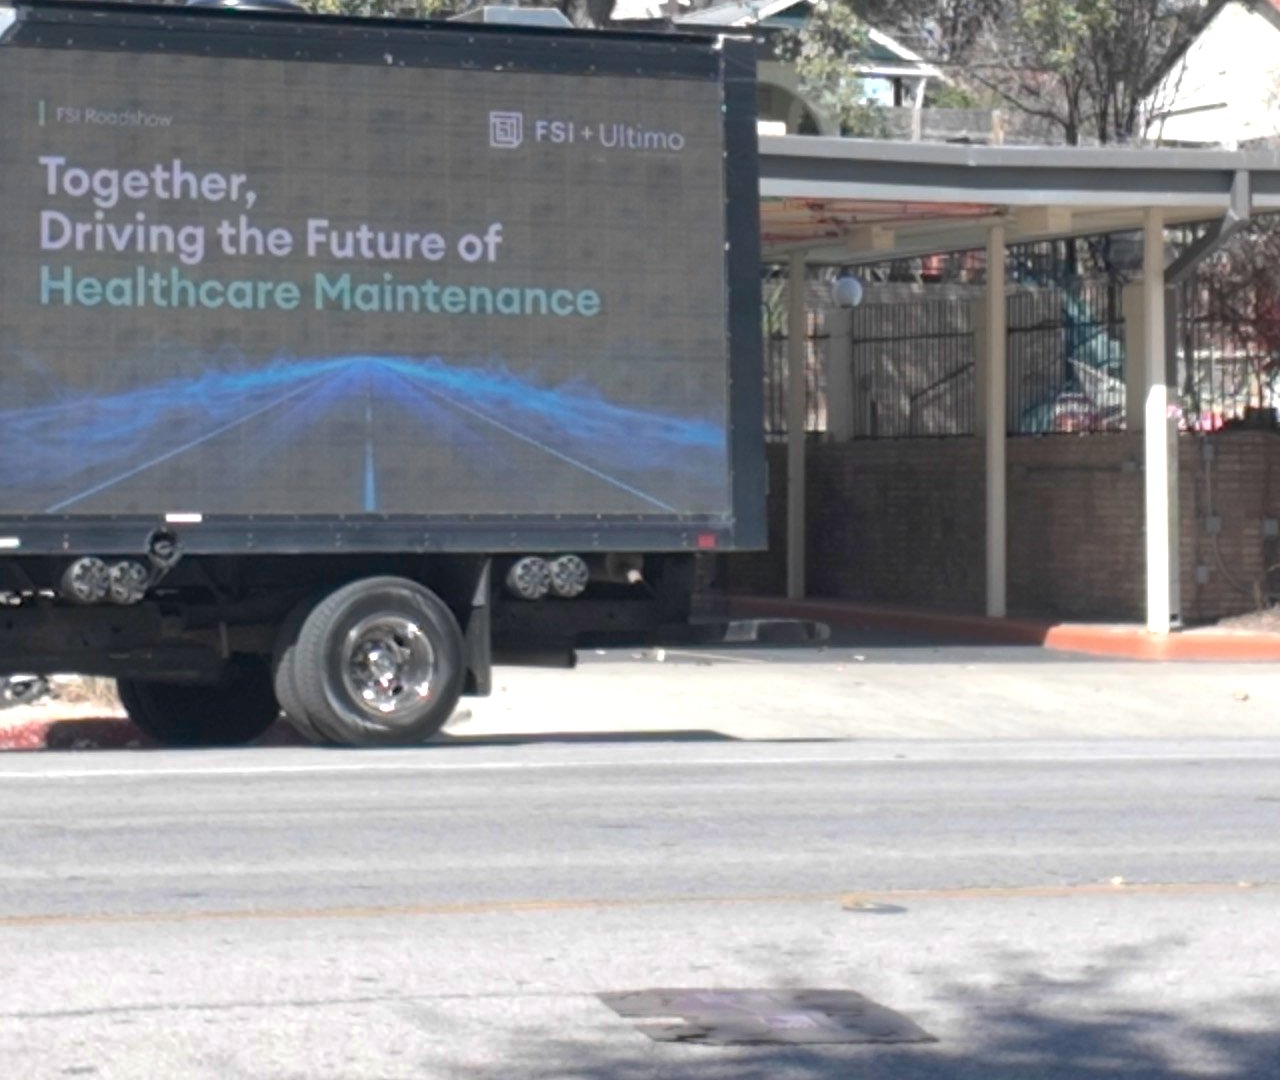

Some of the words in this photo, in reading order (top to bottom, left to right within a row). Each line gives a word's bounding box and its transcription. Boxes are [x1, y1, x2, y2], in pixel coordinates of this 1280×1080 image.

[56, 107, 81, 123] FSI
[85, 108, 173, 127] Roadshow
[535, 120, 574, 143] FSI
[599, 123, 685, 151] Ultimo
[39, 156, 257, 209] Together,
[39, 210, 206, 267] Driving
[217, 217, 293, 257] the
[307, 219, 446, 260] Future
[457, 223, 504, 263] of
[39, 265, 301, 310] Healthcare
[314, 272, 602, 317] Maintenance
